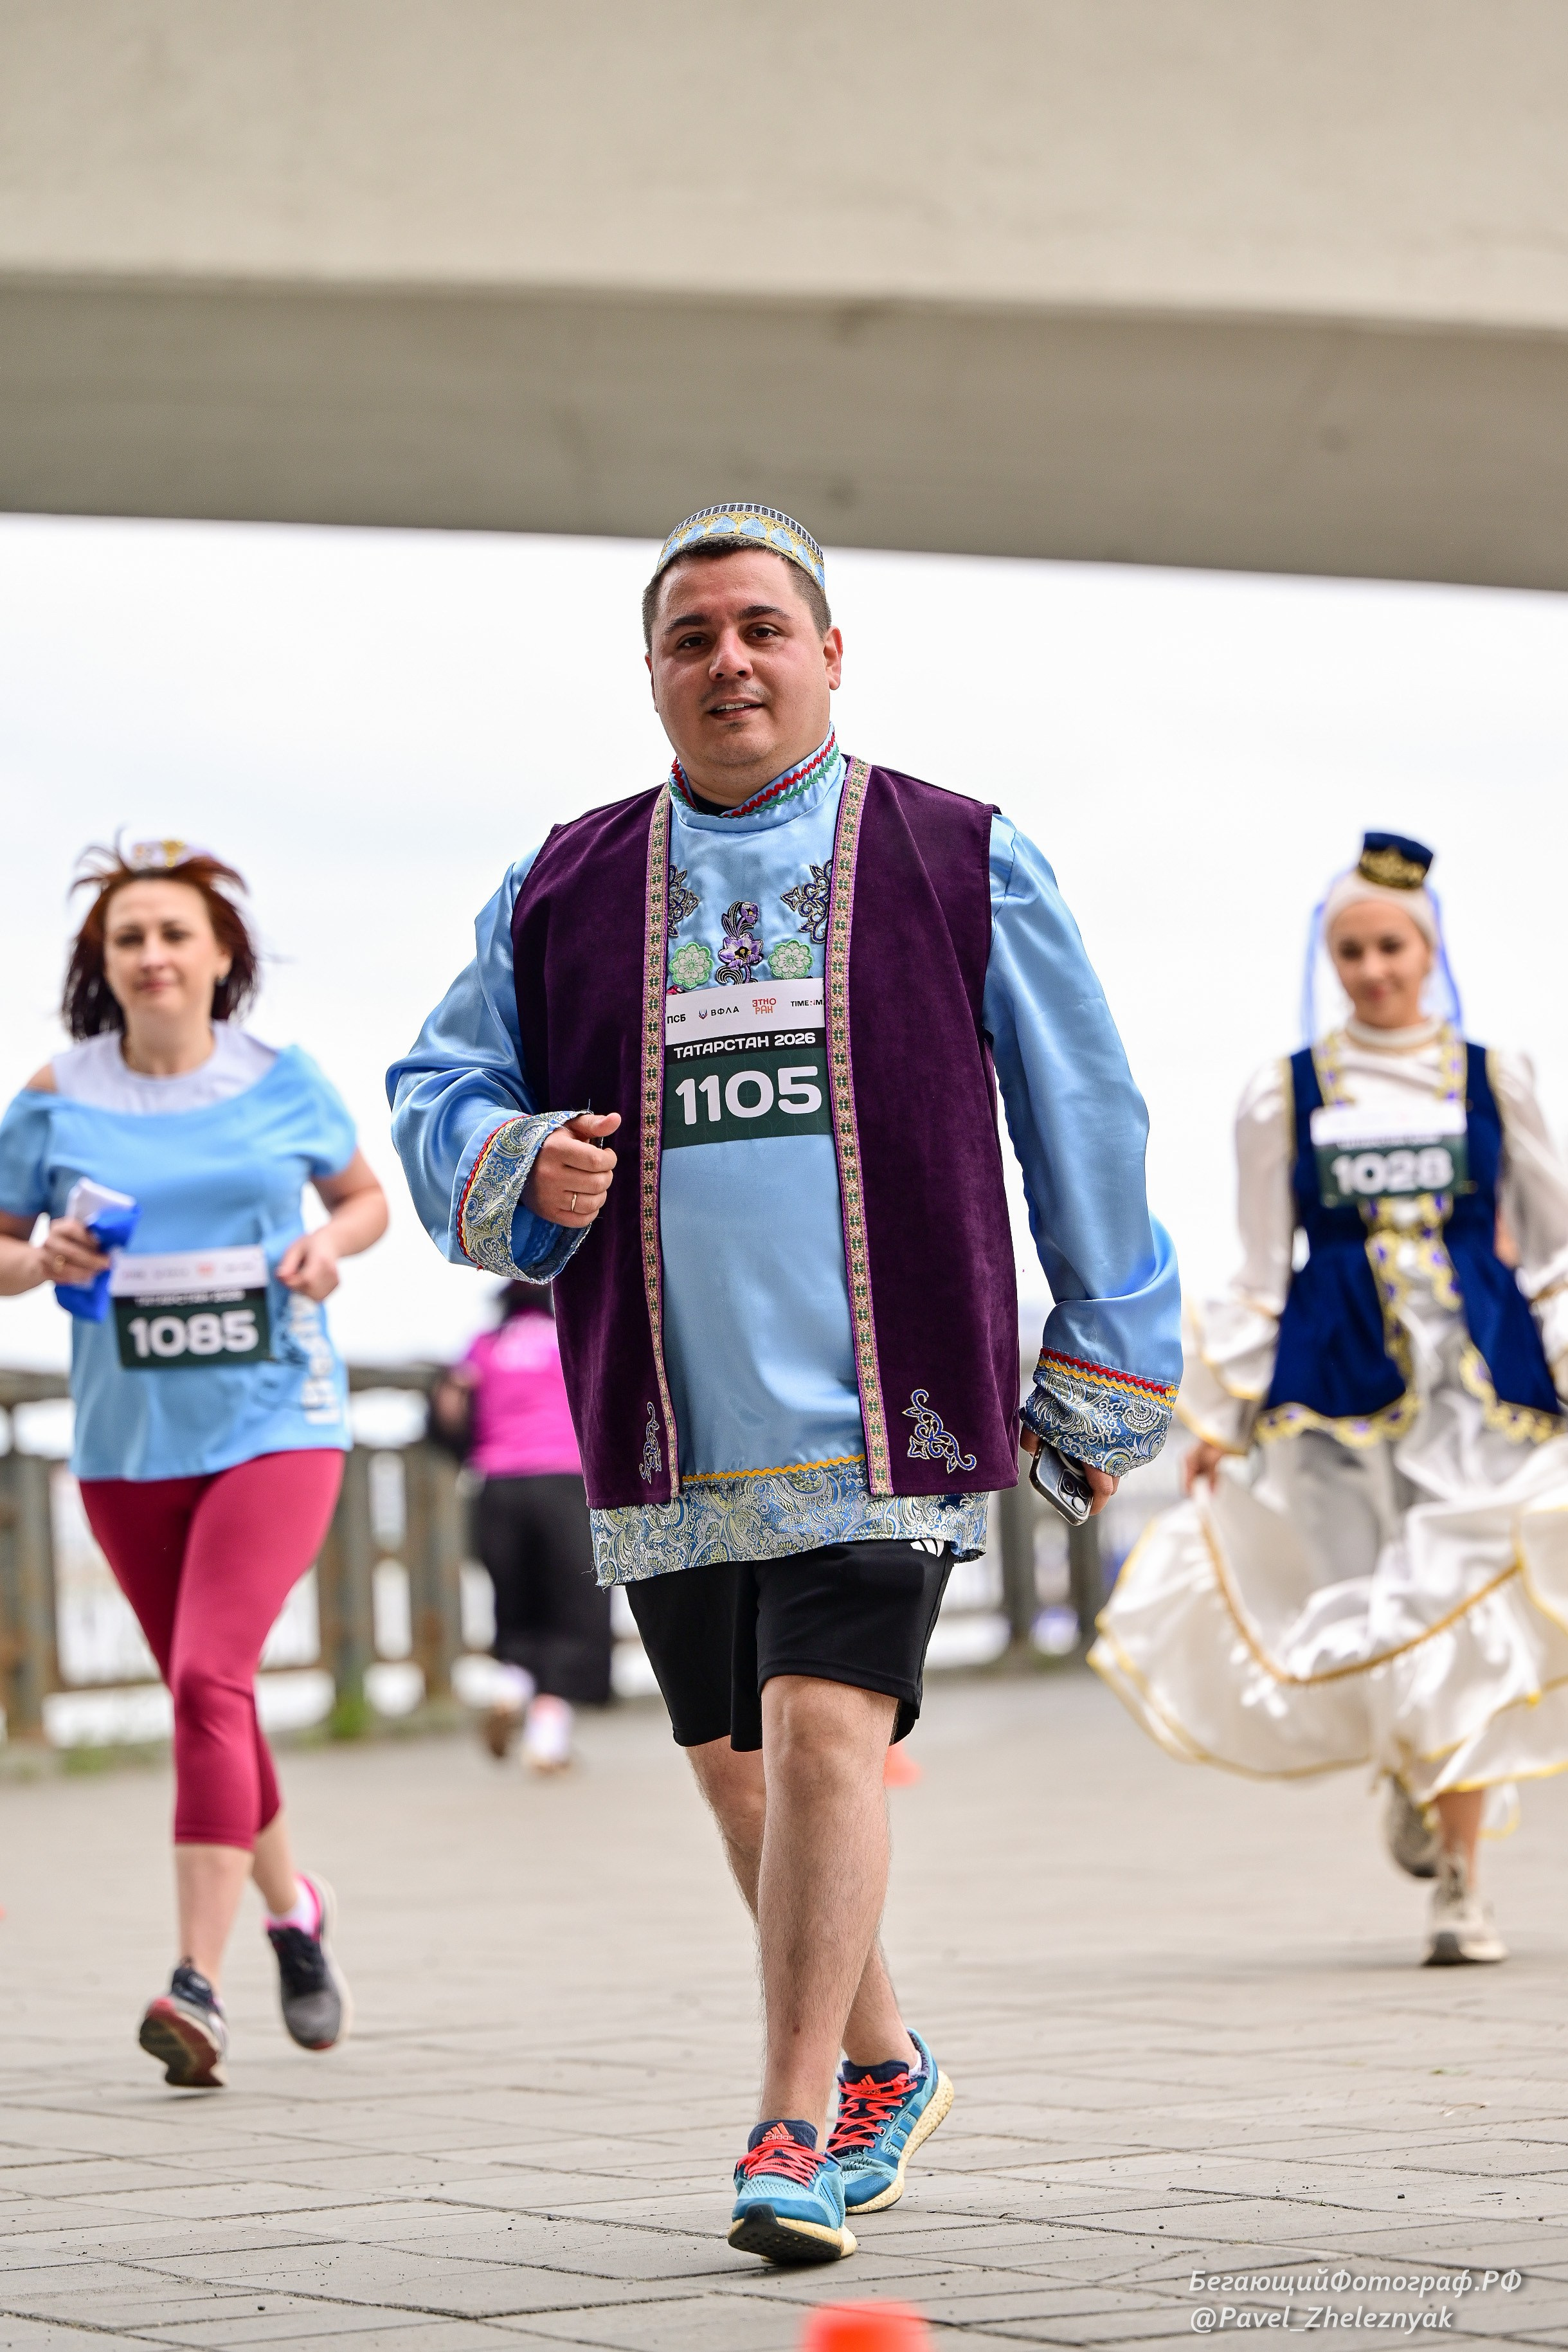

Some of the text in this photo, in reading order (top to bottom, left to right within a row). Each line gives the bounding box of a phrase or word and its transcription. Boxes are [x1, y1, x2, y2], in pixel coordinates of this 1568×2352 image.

[752, 998, 777, 1008] ЭТНО
[710, 1006, 740, 1017] ВФЛА
[755, 1005, 773, 1015] РАН
[667, 1013, 687, 1024] ПСБ
[673, 1032, 816, 1059] ТАТАРСТАН 2026
[675, 1065, 822, 1125] 1105
[129, 1308, 259, 1358] 1085
[762, 2133, 795, 2142] adidas
